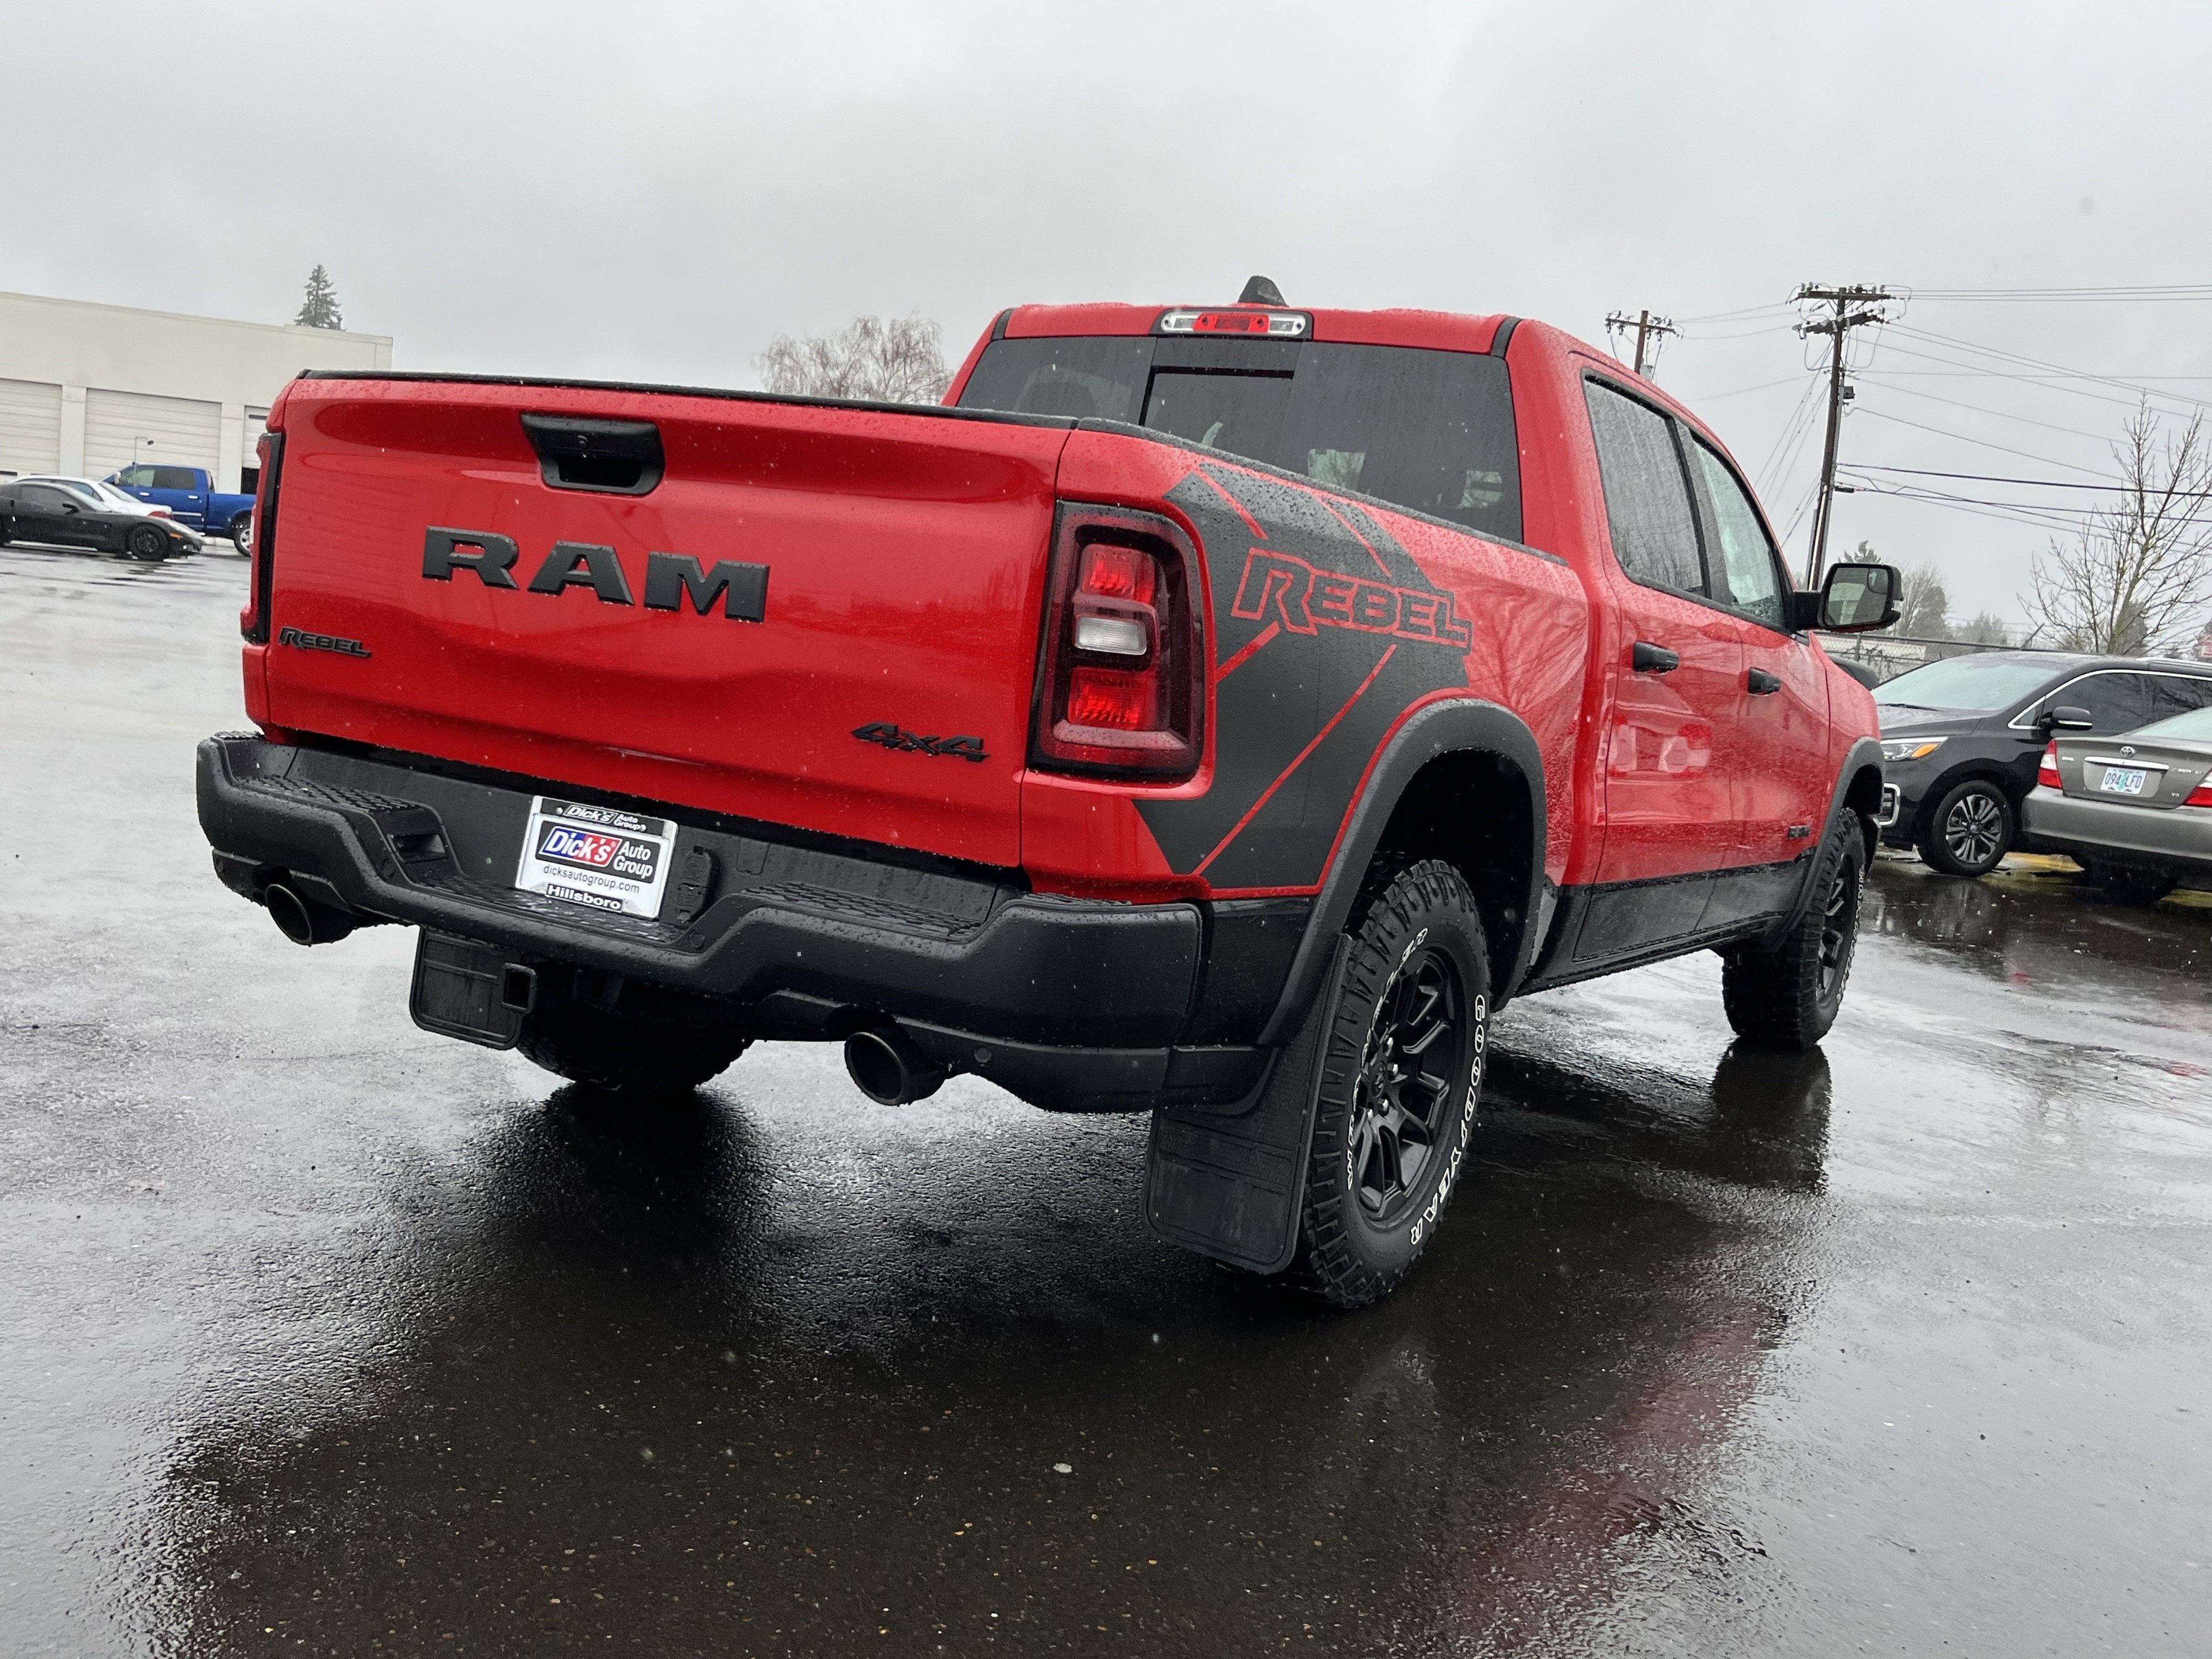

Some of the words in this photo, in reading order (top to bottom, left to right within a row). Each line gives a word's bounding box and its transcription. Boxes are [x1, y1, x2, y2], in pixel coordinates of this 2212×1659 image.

[421, 525, 770, 623] RAM
[1231, 548, 1469, 648] REBEL
[279, 626, 373, 658] REBEL
[567, 806, 613, 822] Dick's
[617, 814, 639, 823] Auto
[613, 819, 641, 831] Group
[545, 830, 612, 862] Dick's
[618, 840, 651, 861] Auto
[543, 864, 640, 893] dicksautogroup.com
[613, 855, 653, 879] Group
[548, 884, 622, 910] Hillsboro
[1411, 994, 1486, 1245] GOODYEAR
